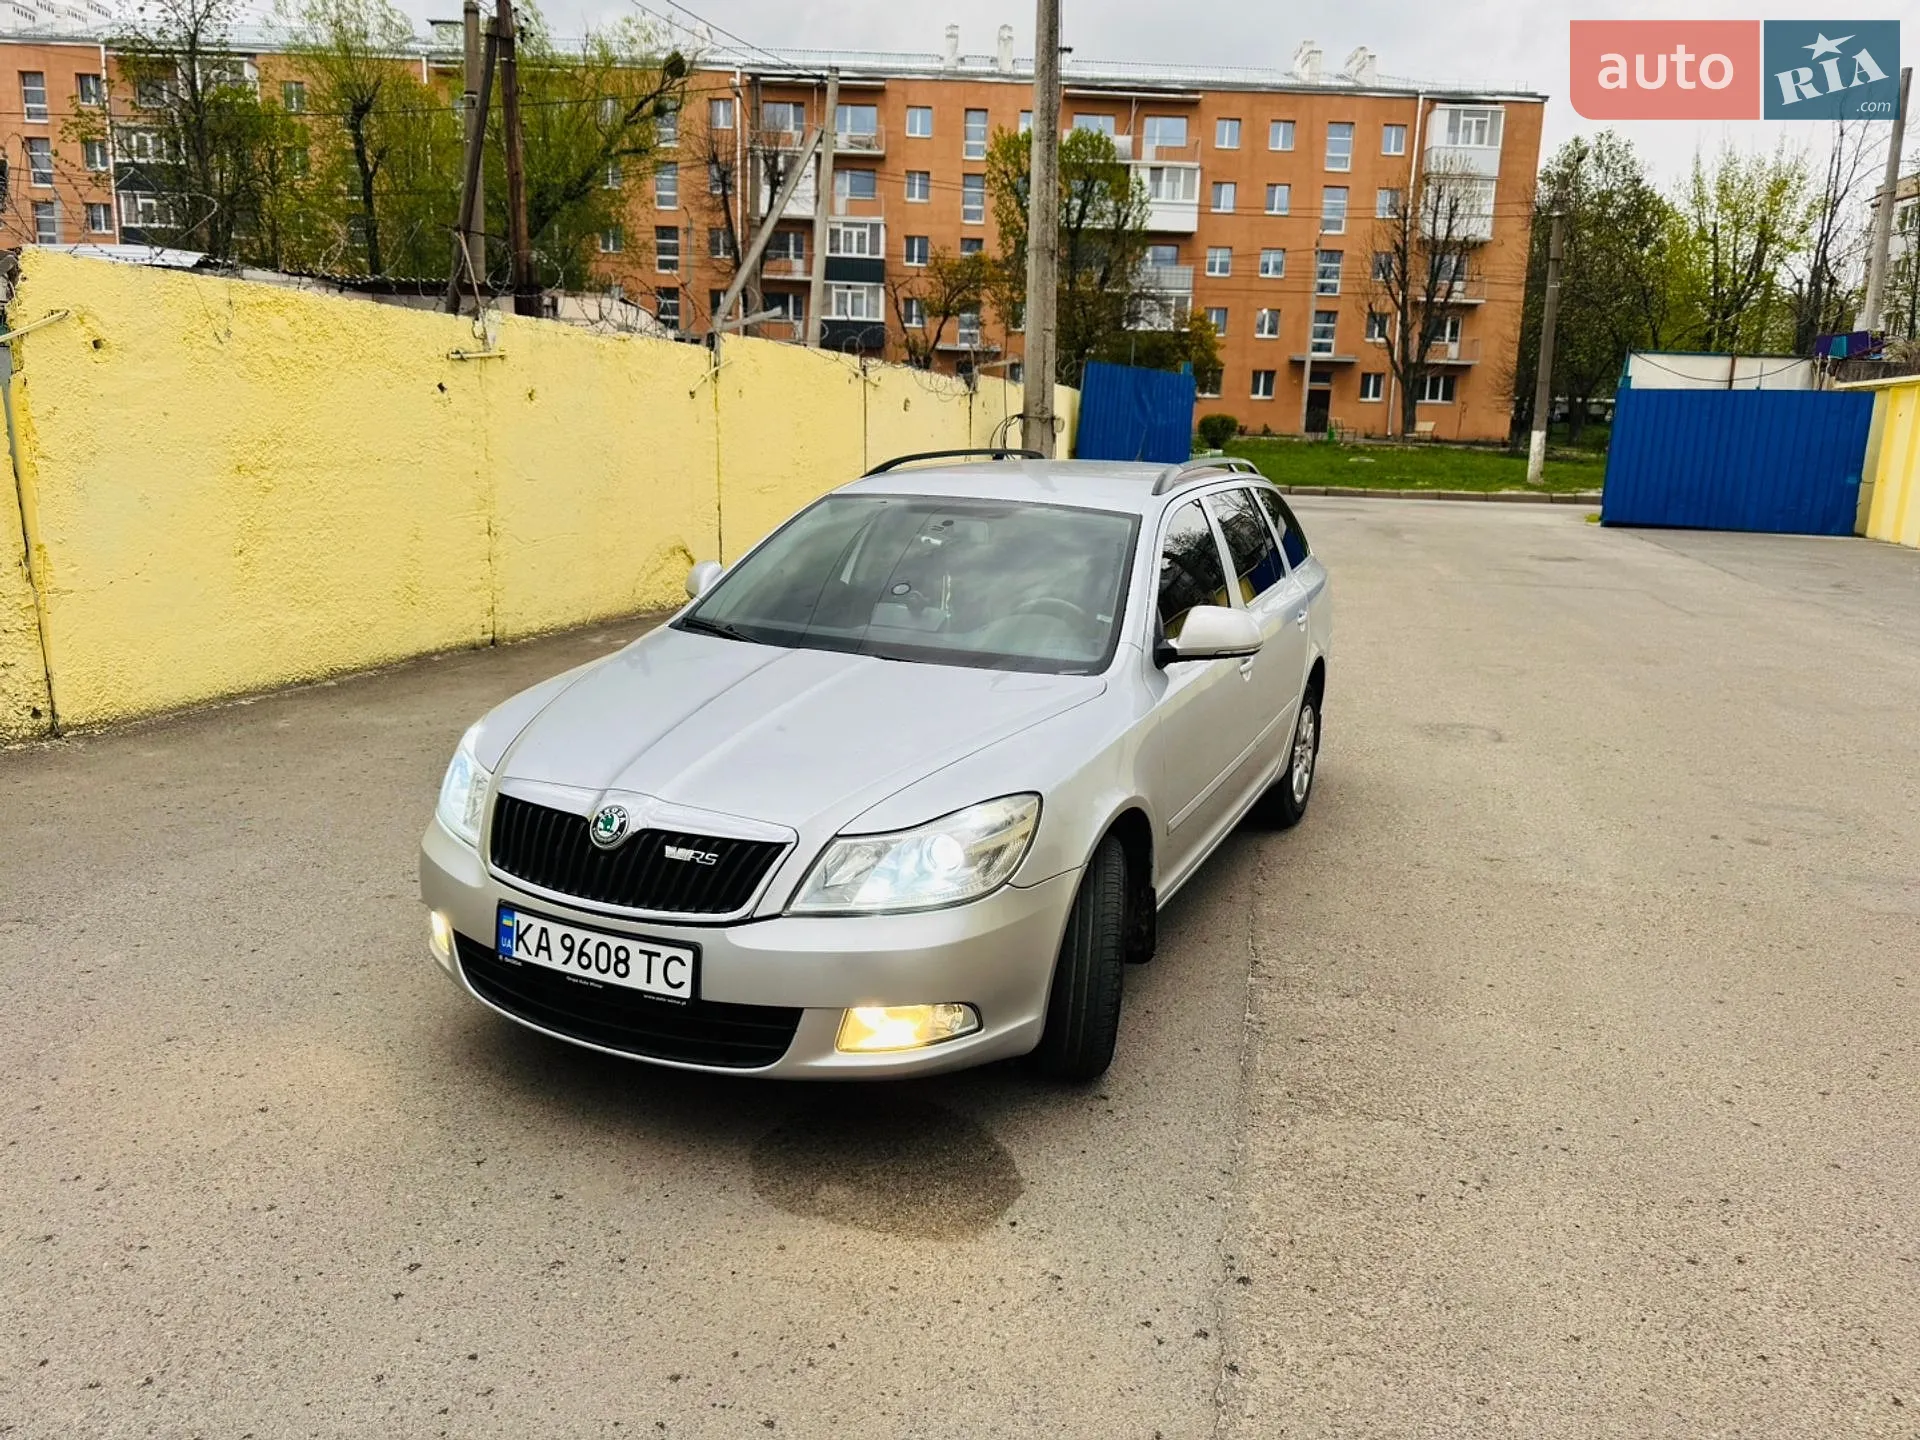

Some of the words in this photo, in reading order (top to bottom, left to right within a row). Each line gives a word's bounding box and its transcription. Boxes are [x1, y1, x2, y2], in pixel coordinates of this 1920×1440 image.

[501, 935, 513, 949] UA
[515, 919, 553, 962] KA
[560, 933, 631, 979] 9608
[639, 949, 687, 990] TC
